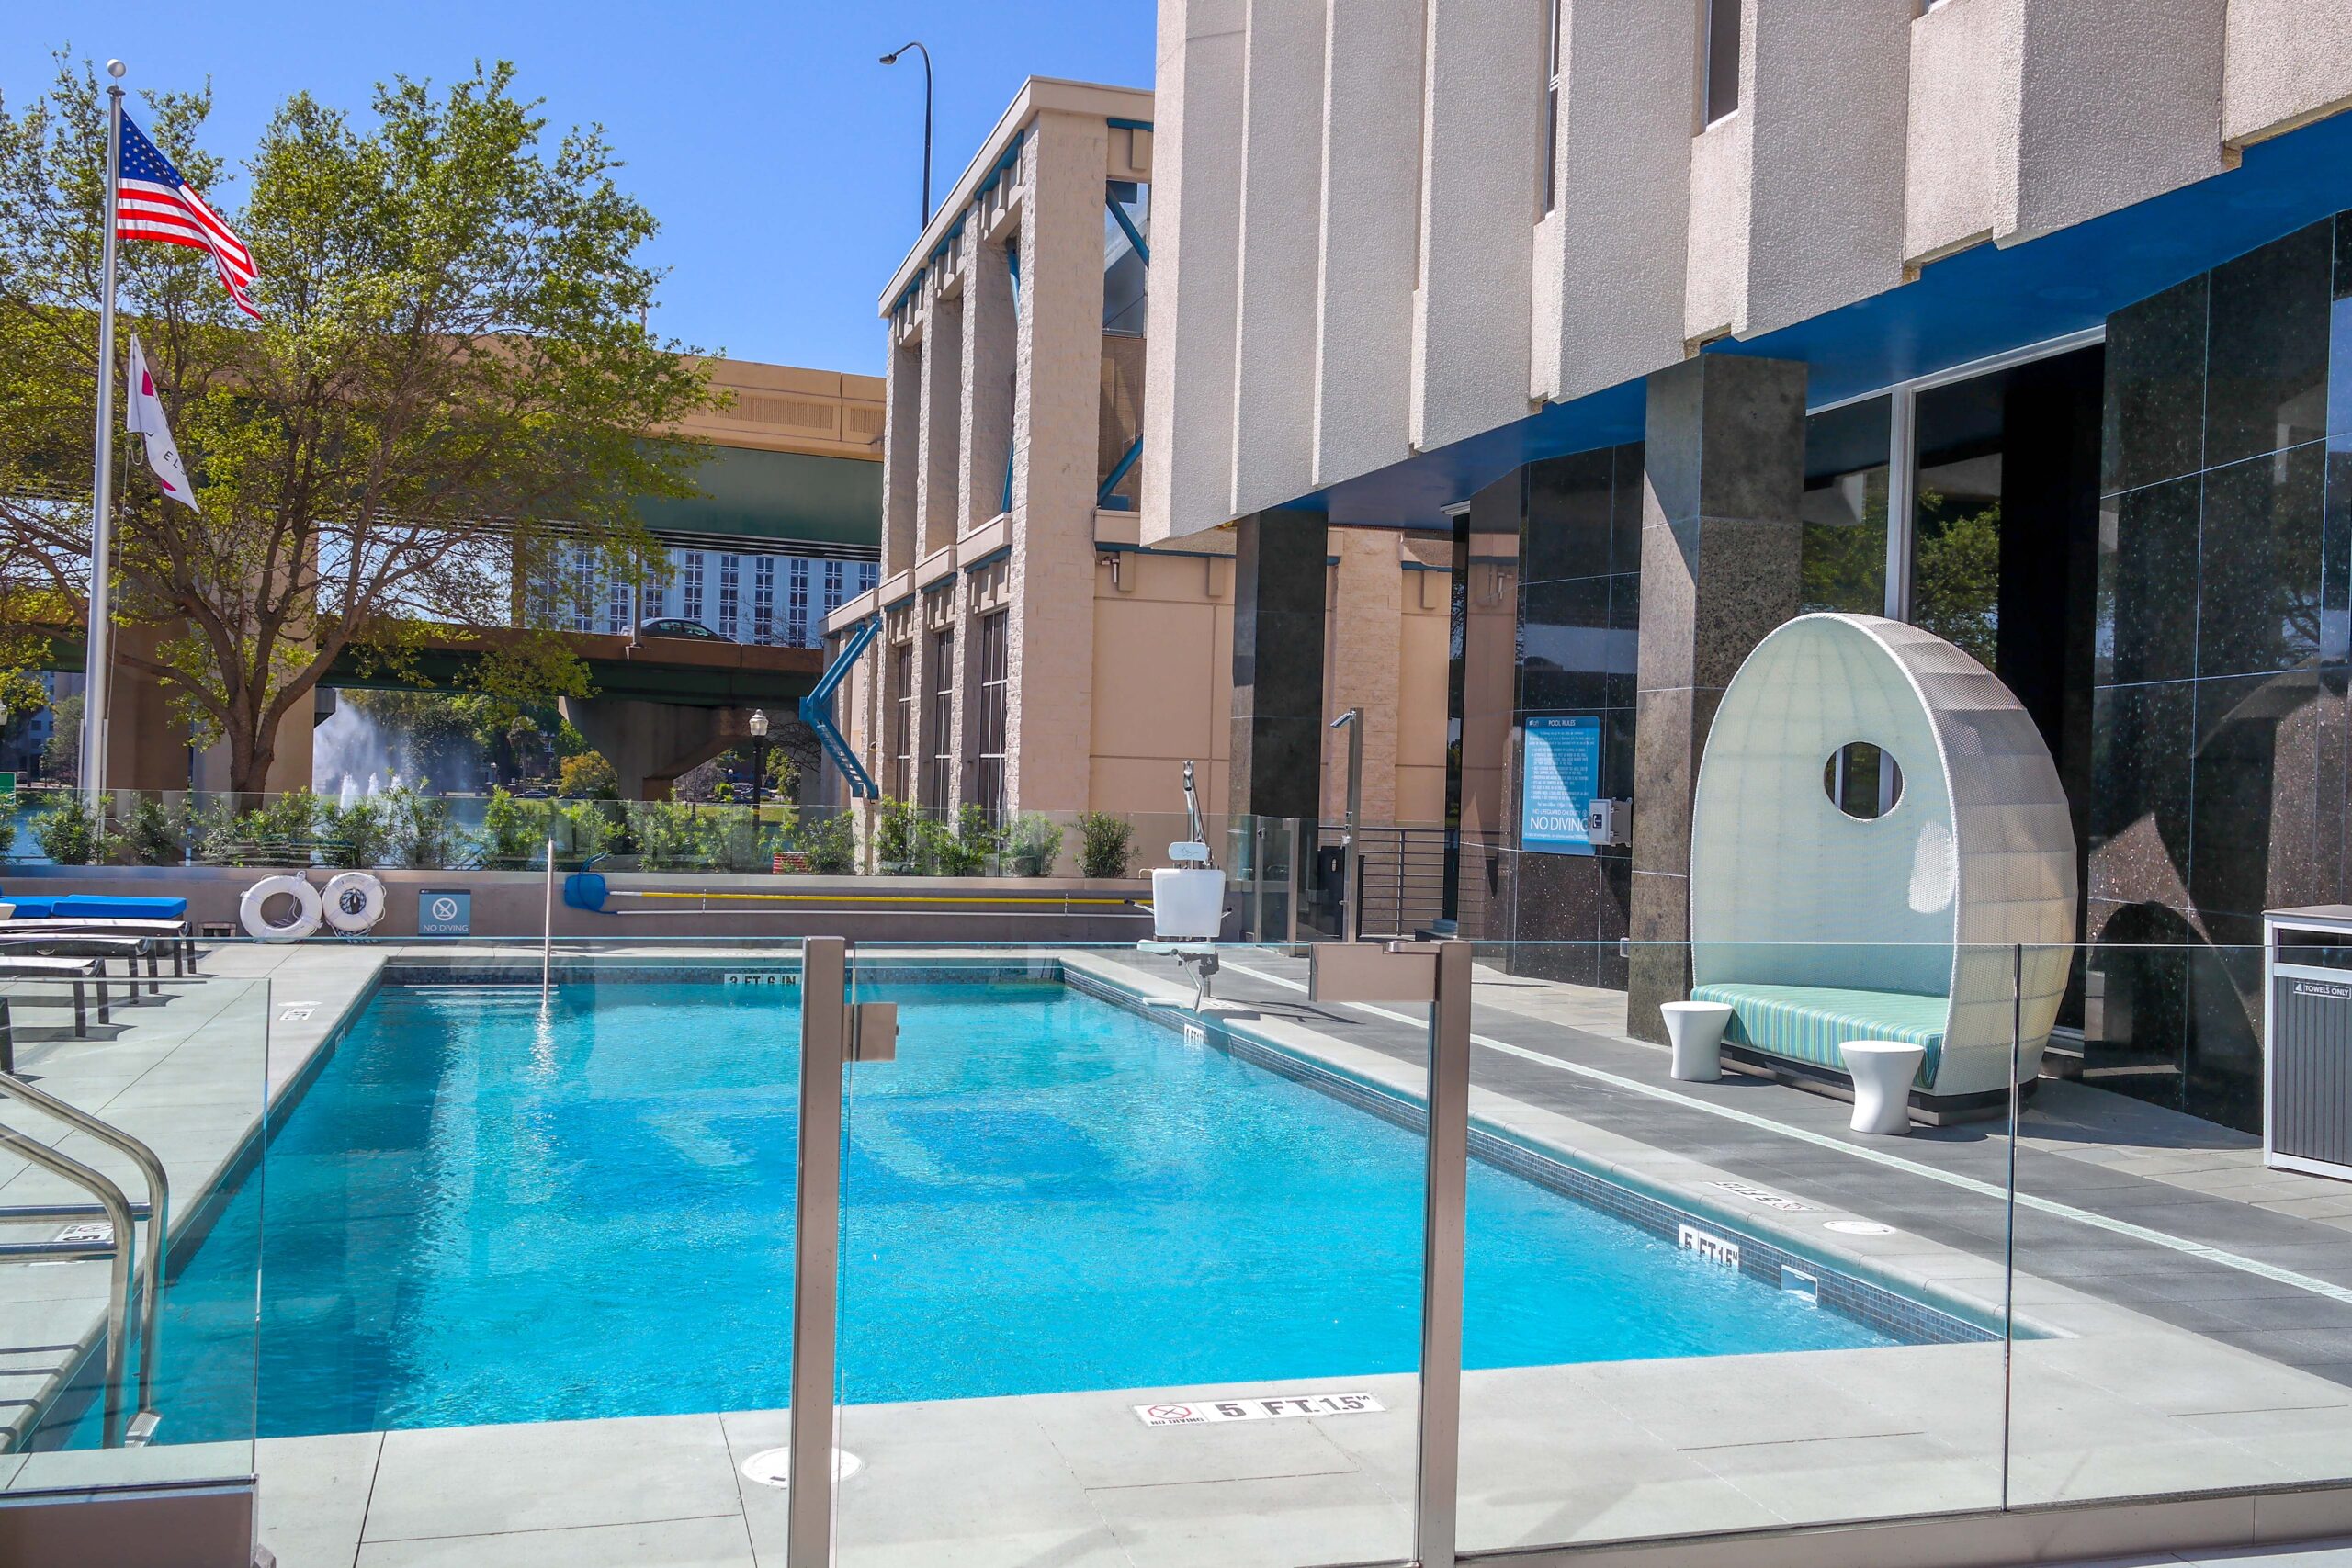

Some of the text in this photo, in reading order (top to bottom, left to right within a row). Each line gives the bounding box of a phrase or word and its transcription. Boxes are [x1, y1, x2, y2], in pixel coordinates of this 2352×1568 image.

[1530, 816, 1589, 832] NO DIVING
[781, 976, 797, 985] IN
[2304, 985, 2349, 997] TOWELS ONLY
[1699, 1237, 1716, 1259] FT
[1214, 1403, 1247, 1417] 5
